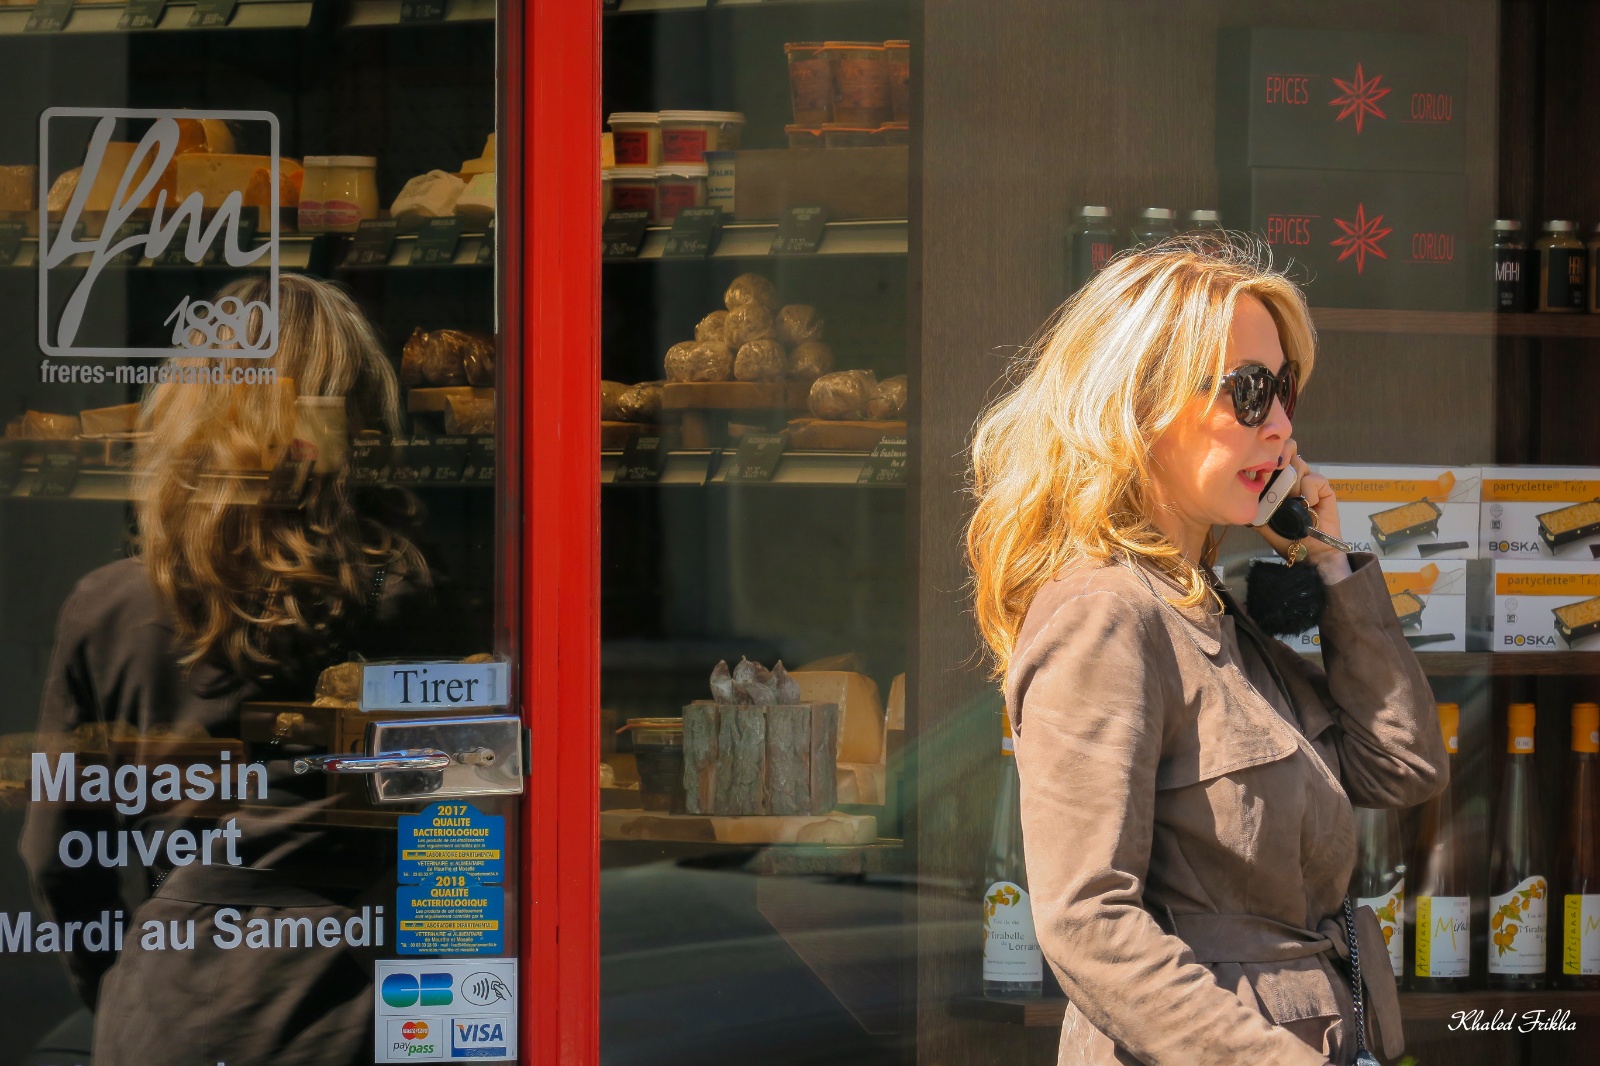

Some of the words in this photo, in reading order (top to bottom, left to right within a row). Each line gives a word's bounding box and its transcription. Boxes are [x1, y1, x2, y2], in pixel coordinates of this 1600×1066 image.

[1266, 76, 1309, 105] EPICES
[1411, 93, 1453, 121] CORLOU
[1267, 217, 1311, 245] EPICES
[1412, 232, 1455, 261] CORLOU
[1495, 261, 1520, 282] MAKI
[163, 295, 272, 350] 1880
[40, 360, 277, 385] freres-marchand.com
[1489, 540, 1540, 553] BOSKA
[1504, 634, 1556, 647] BOSKA
[393, 668, 479, 704] Tirer
[31, 751, 268, 815] Magasin
[437, 805, 467, 816] 2017
[413, 828, 489, 837] BACTERIOLOGIQUE
[432, 817, 471, 827] QUALITE
[59, 818, 243, 868] ouvert
[435, 875, 466, 887] 2018
[411, 899, 488, 907] BACTERIOLOGIQUE
[430, 888, 469, 898] QUALITE
[0, 909, 123, 953] Mardi
[141, 919, 195, 951] au
[213, 906, 384, 950] Samedi
[987, 931, 1025, 940] Mirabelle
[455, 1024, 504, 1042] VISA
